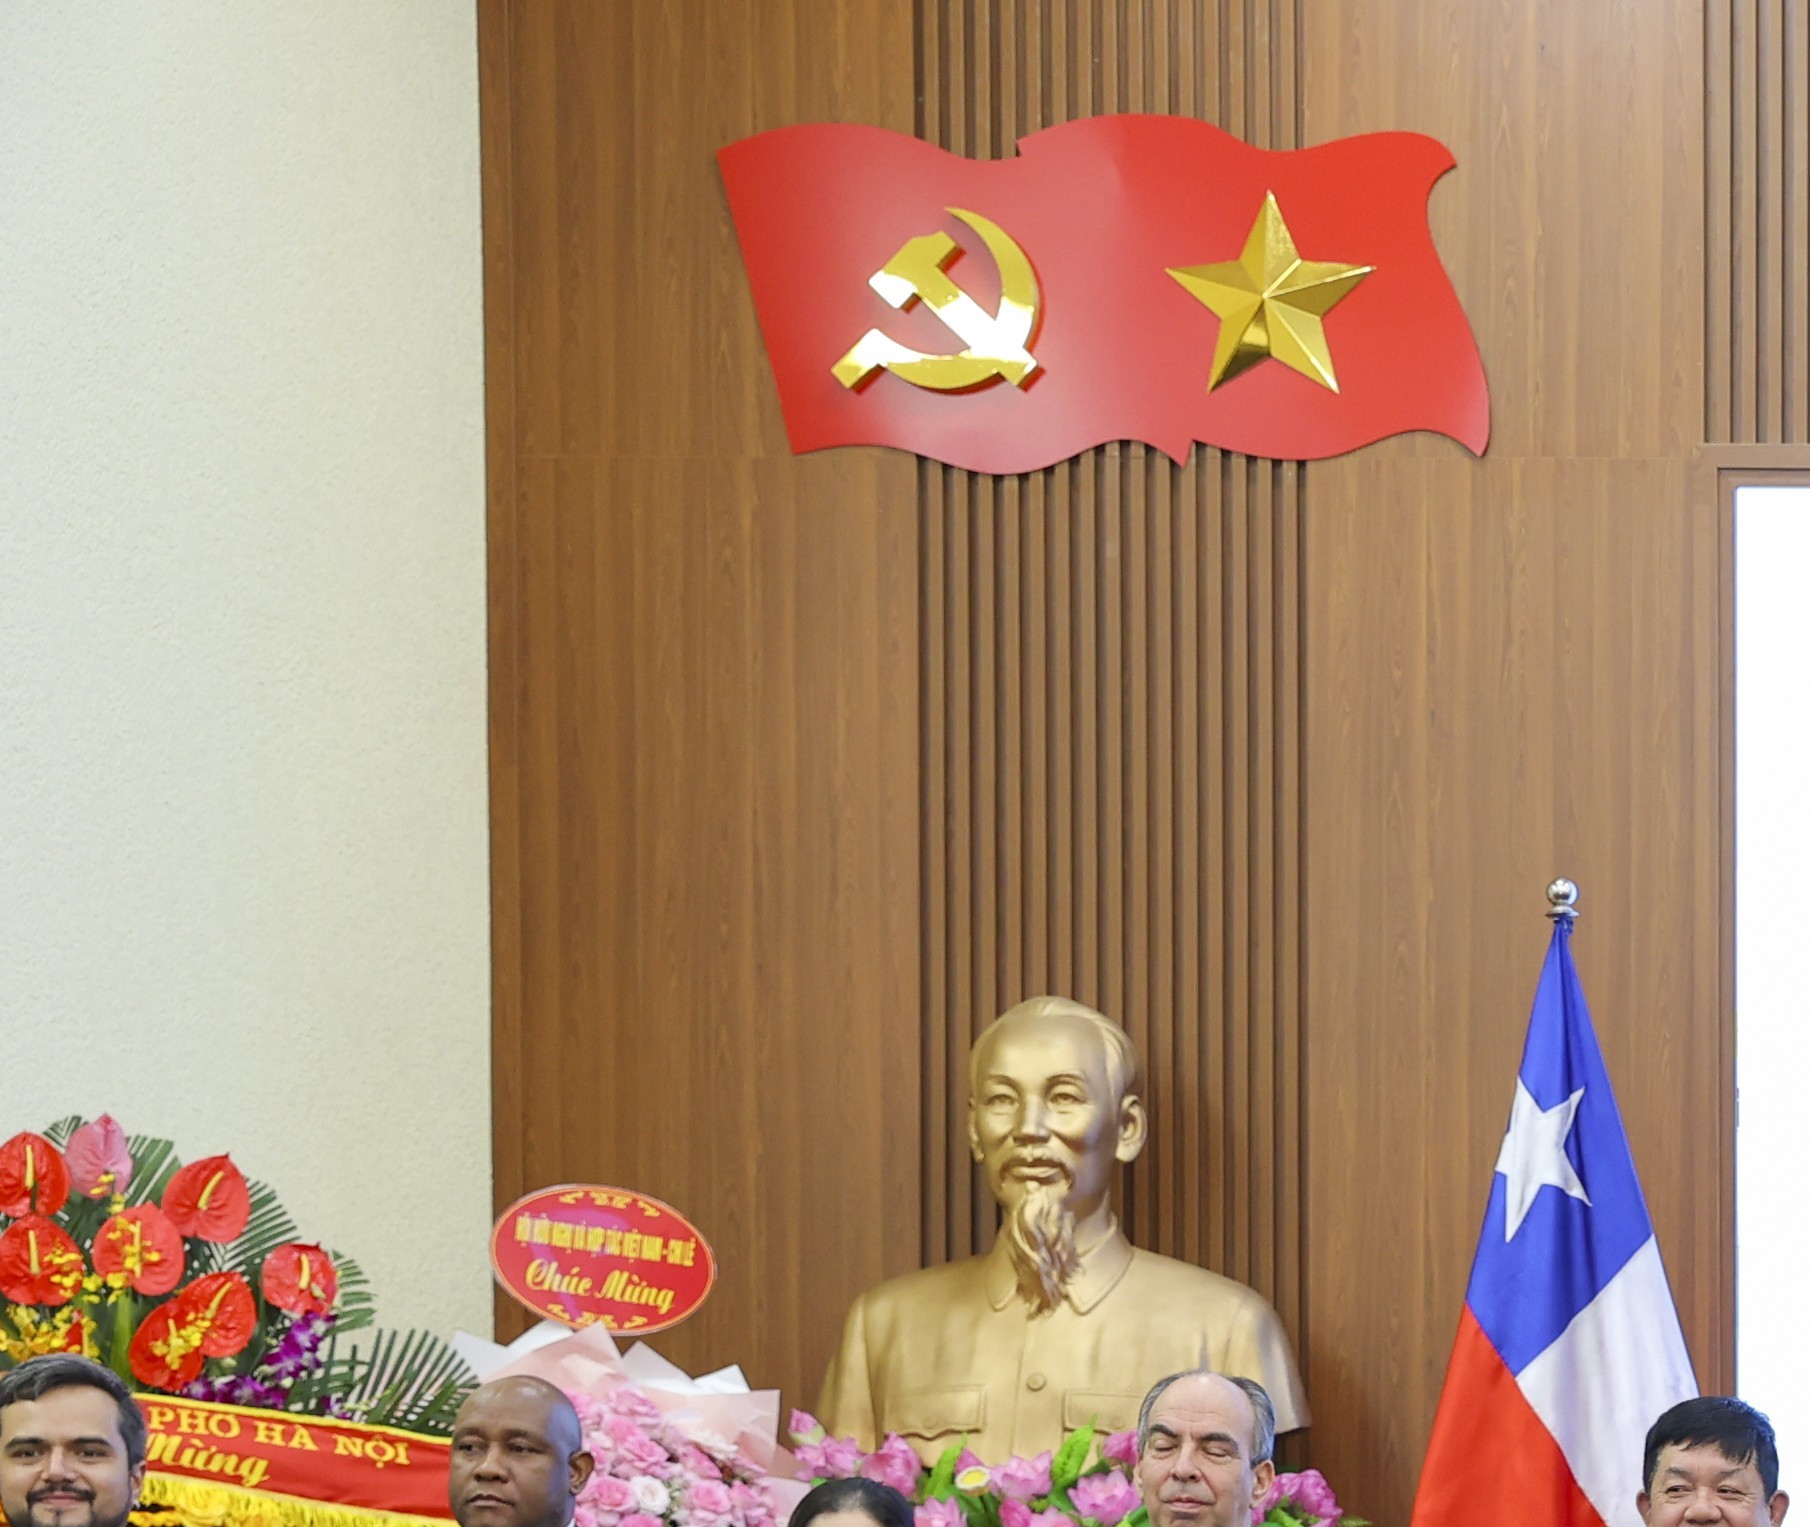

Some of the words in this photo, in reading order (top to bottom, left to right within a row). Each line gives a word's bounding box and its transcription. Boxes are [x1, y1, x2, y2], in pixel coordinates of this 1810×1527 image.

[525, 1257, 593, 1297] Chúc
[593, 1269, 676, 1315] Mừng
[331, 1433, 411, 1469] NỘI
